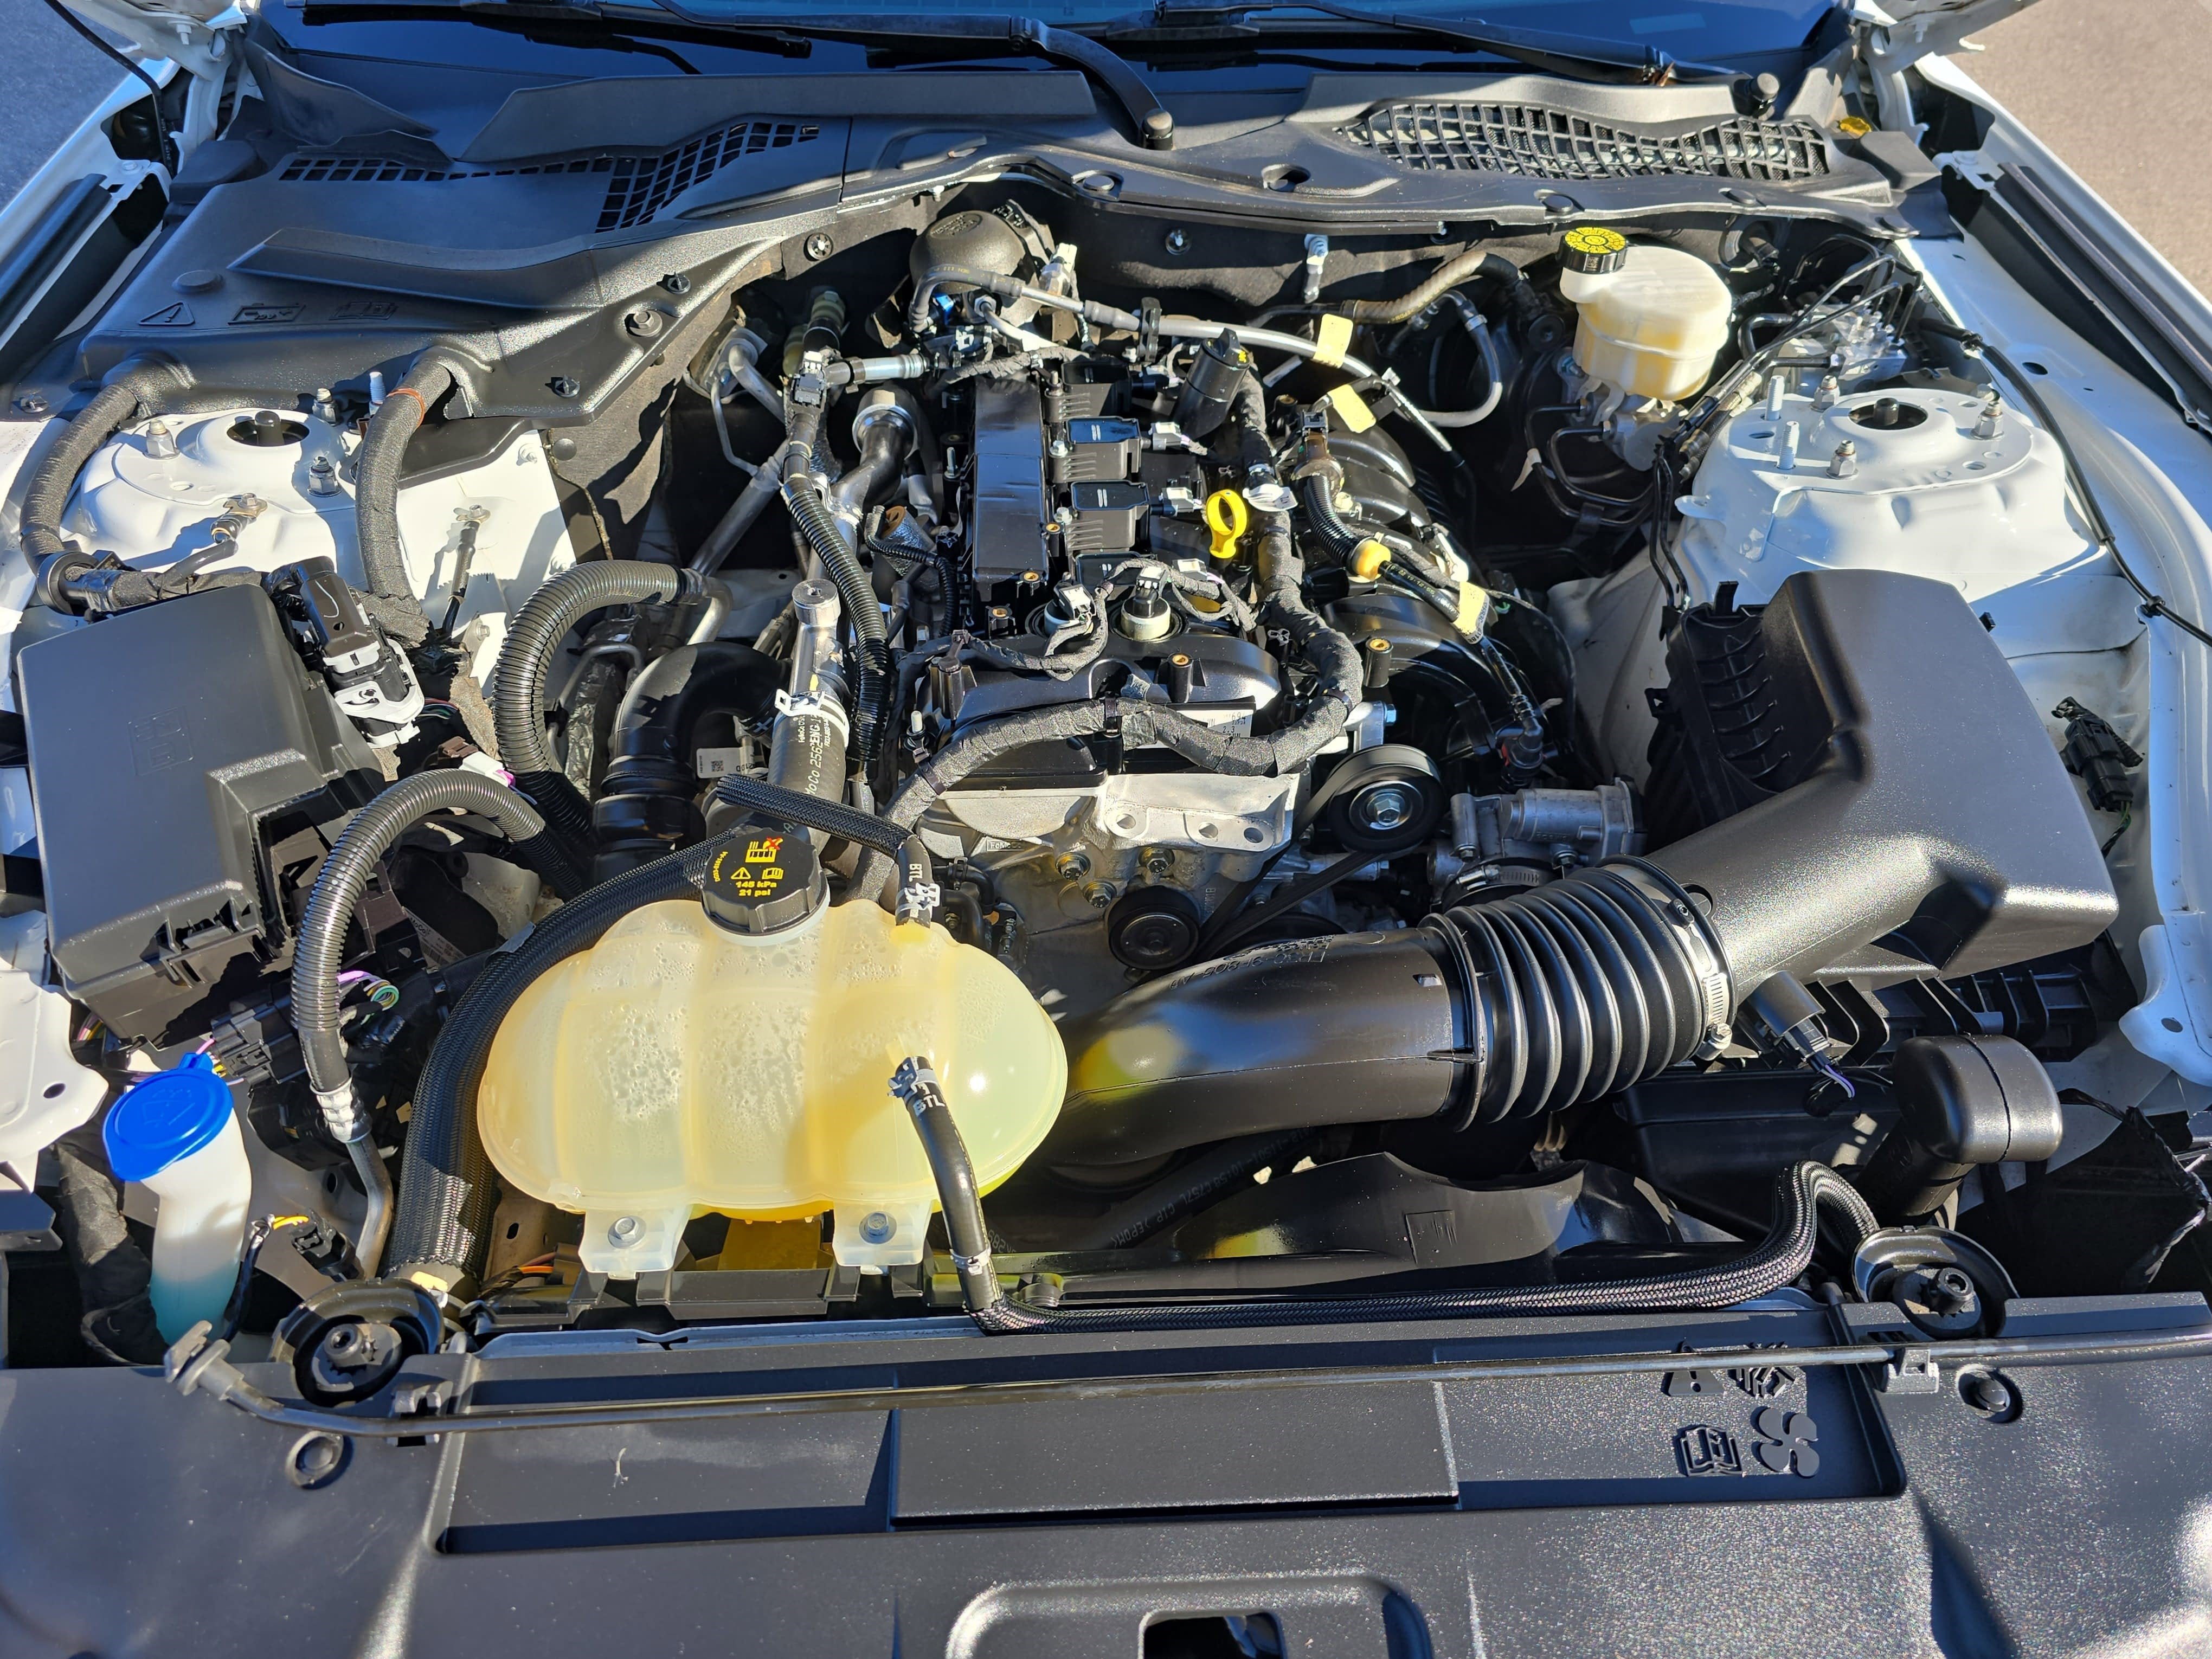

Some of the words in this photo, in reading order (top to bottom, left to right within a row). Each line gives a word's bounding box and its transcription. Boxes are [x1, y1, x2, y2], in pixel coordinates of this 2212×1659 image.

[1222, 725, 1236, 734] 2.3
[805, 770, 820, 795] MoCo
[988, 841, 1021, 850] FoMoCo
[908, 863, 923, 883] BTL
[754, 889, 771, 897] psi
[914, 1094, 946, 1116] BTL
